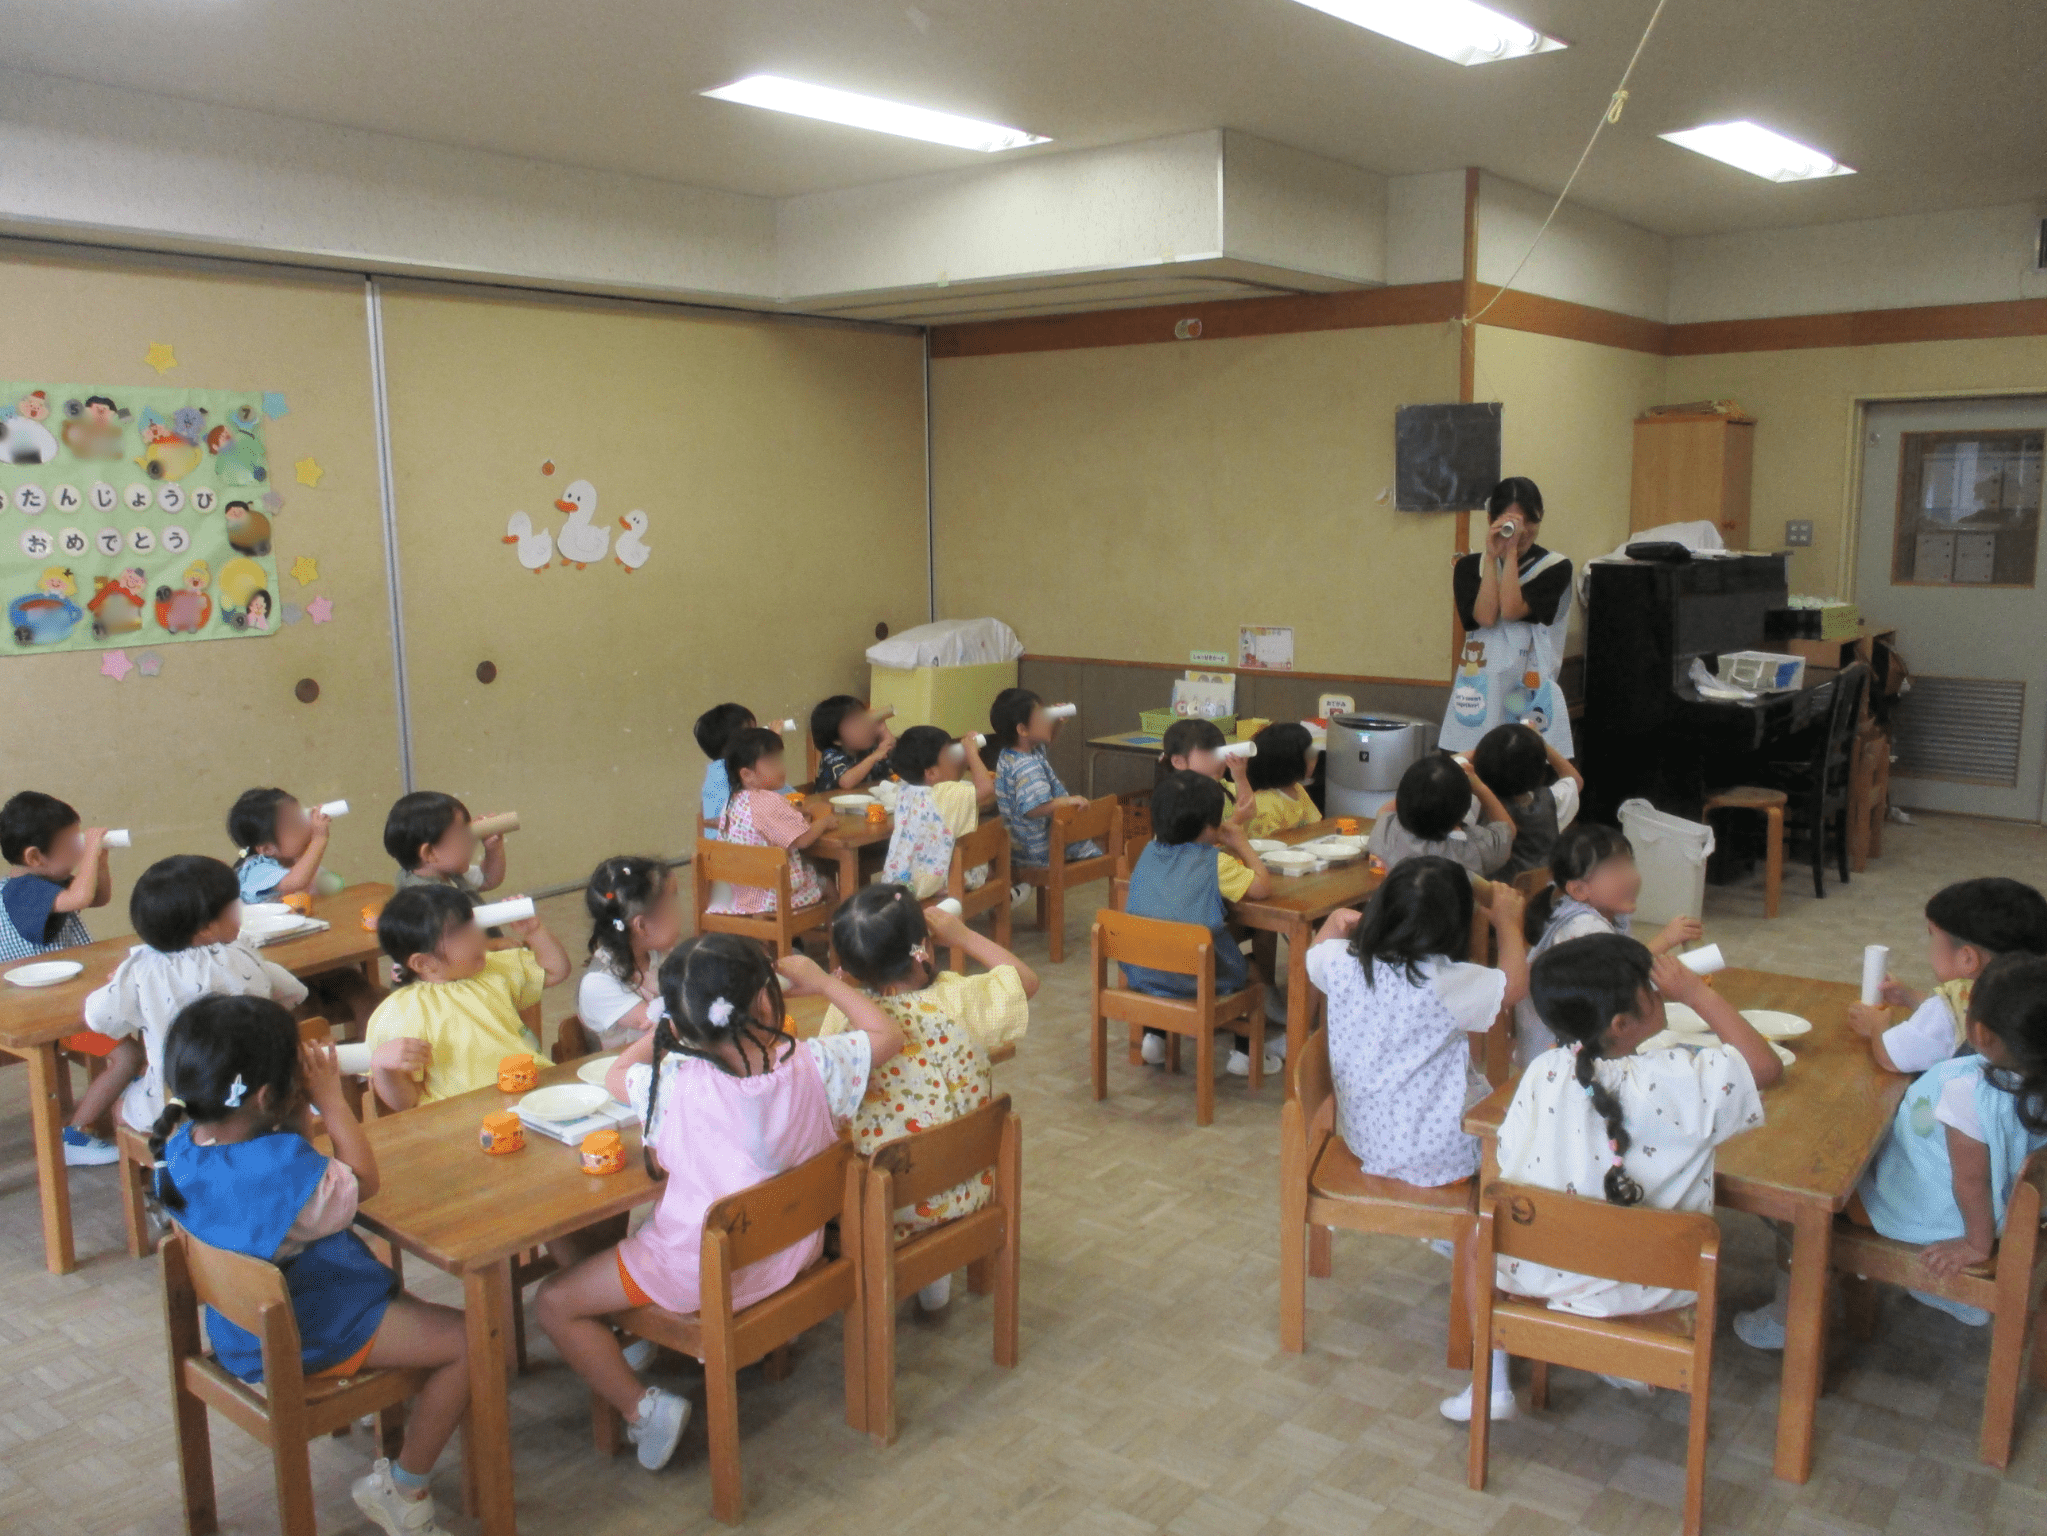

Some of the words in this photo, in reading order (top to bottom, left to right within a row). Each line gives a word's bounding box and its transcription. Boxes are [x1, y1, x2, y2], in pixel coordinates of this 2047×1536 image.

[0, 487, 214, 510] たんじょうび
[27, 531, 184, 554] おめでとう
